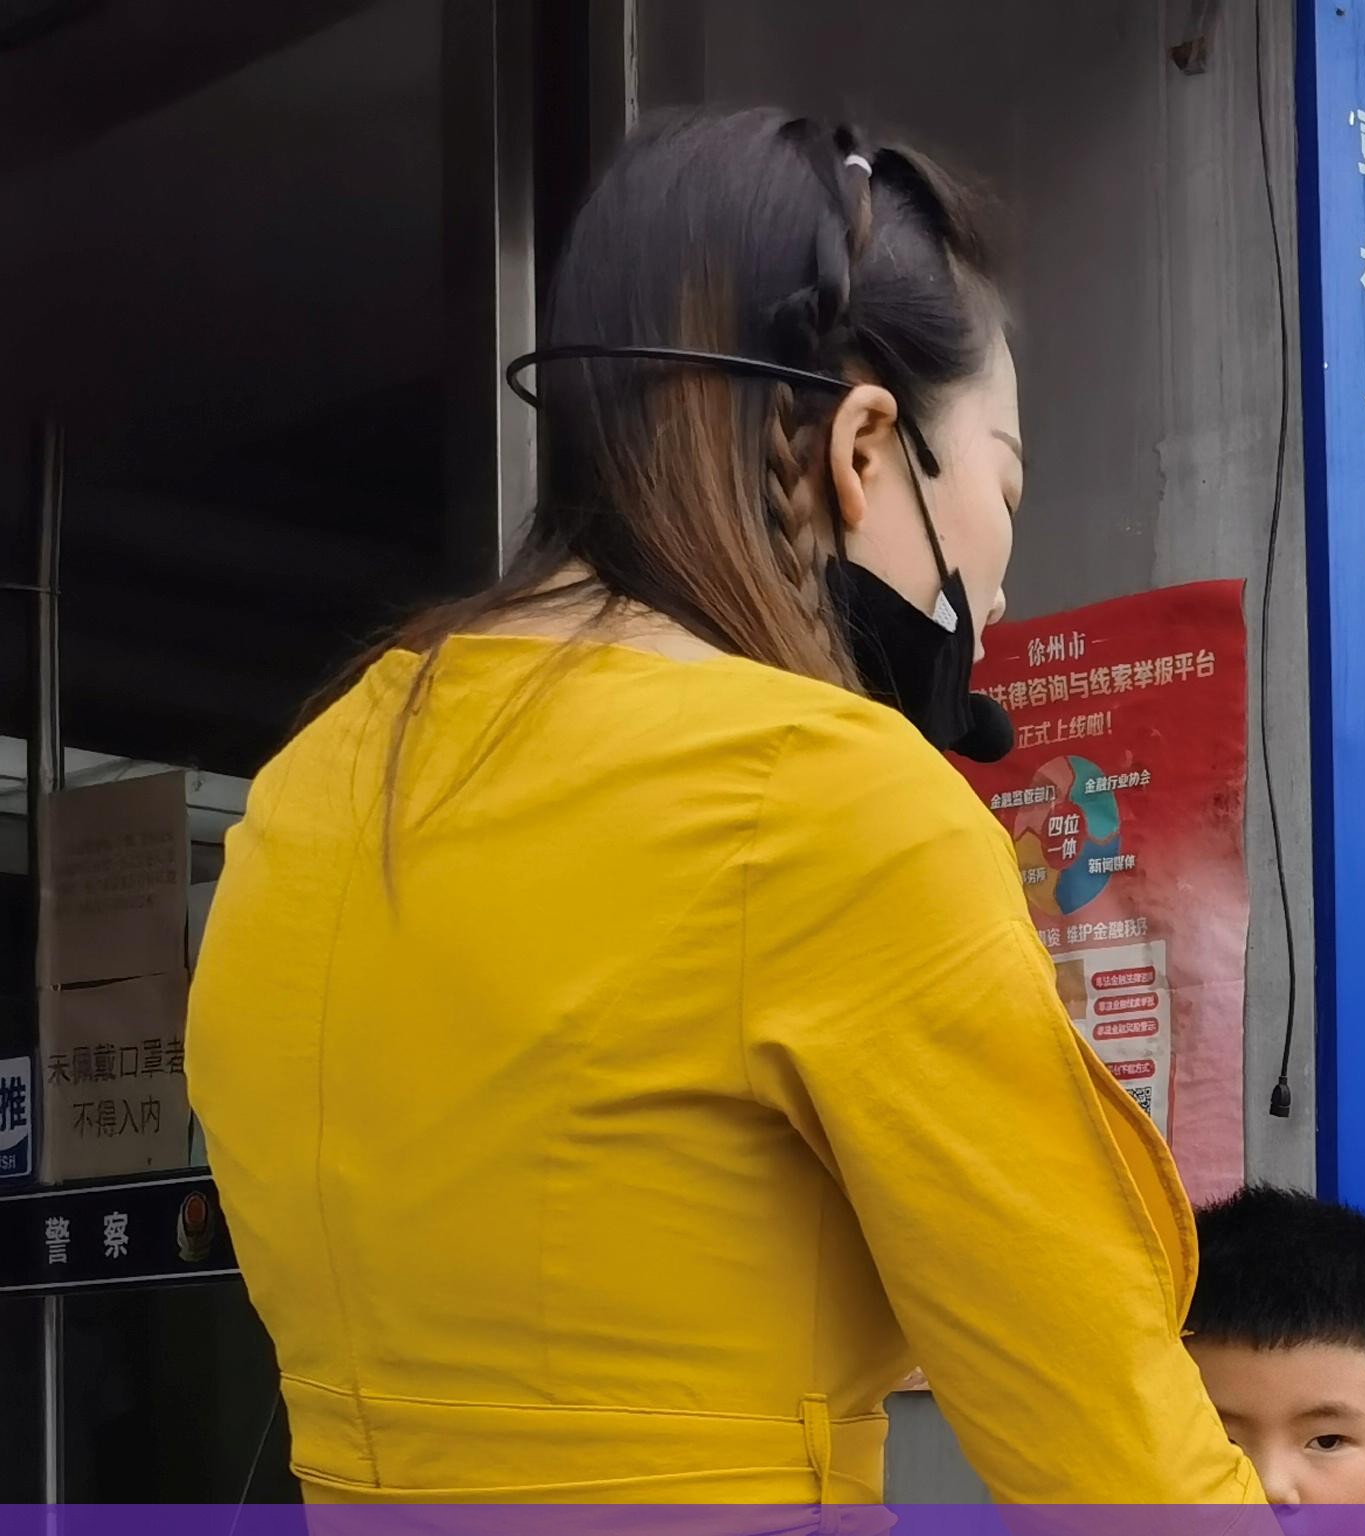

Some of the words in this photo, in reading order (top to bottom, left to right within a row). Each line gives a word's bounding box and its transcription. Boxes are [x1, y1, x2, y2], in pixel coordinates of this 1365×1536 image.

[1028, 631, 1086, 667] 徐州市
[1048, 813, 1080, 837] 四位
[1048, 838, 1078, 860] 一体
[73, 1096, 162, 1138] 不得入内
[45, 1210, 129, 1267] 警察
